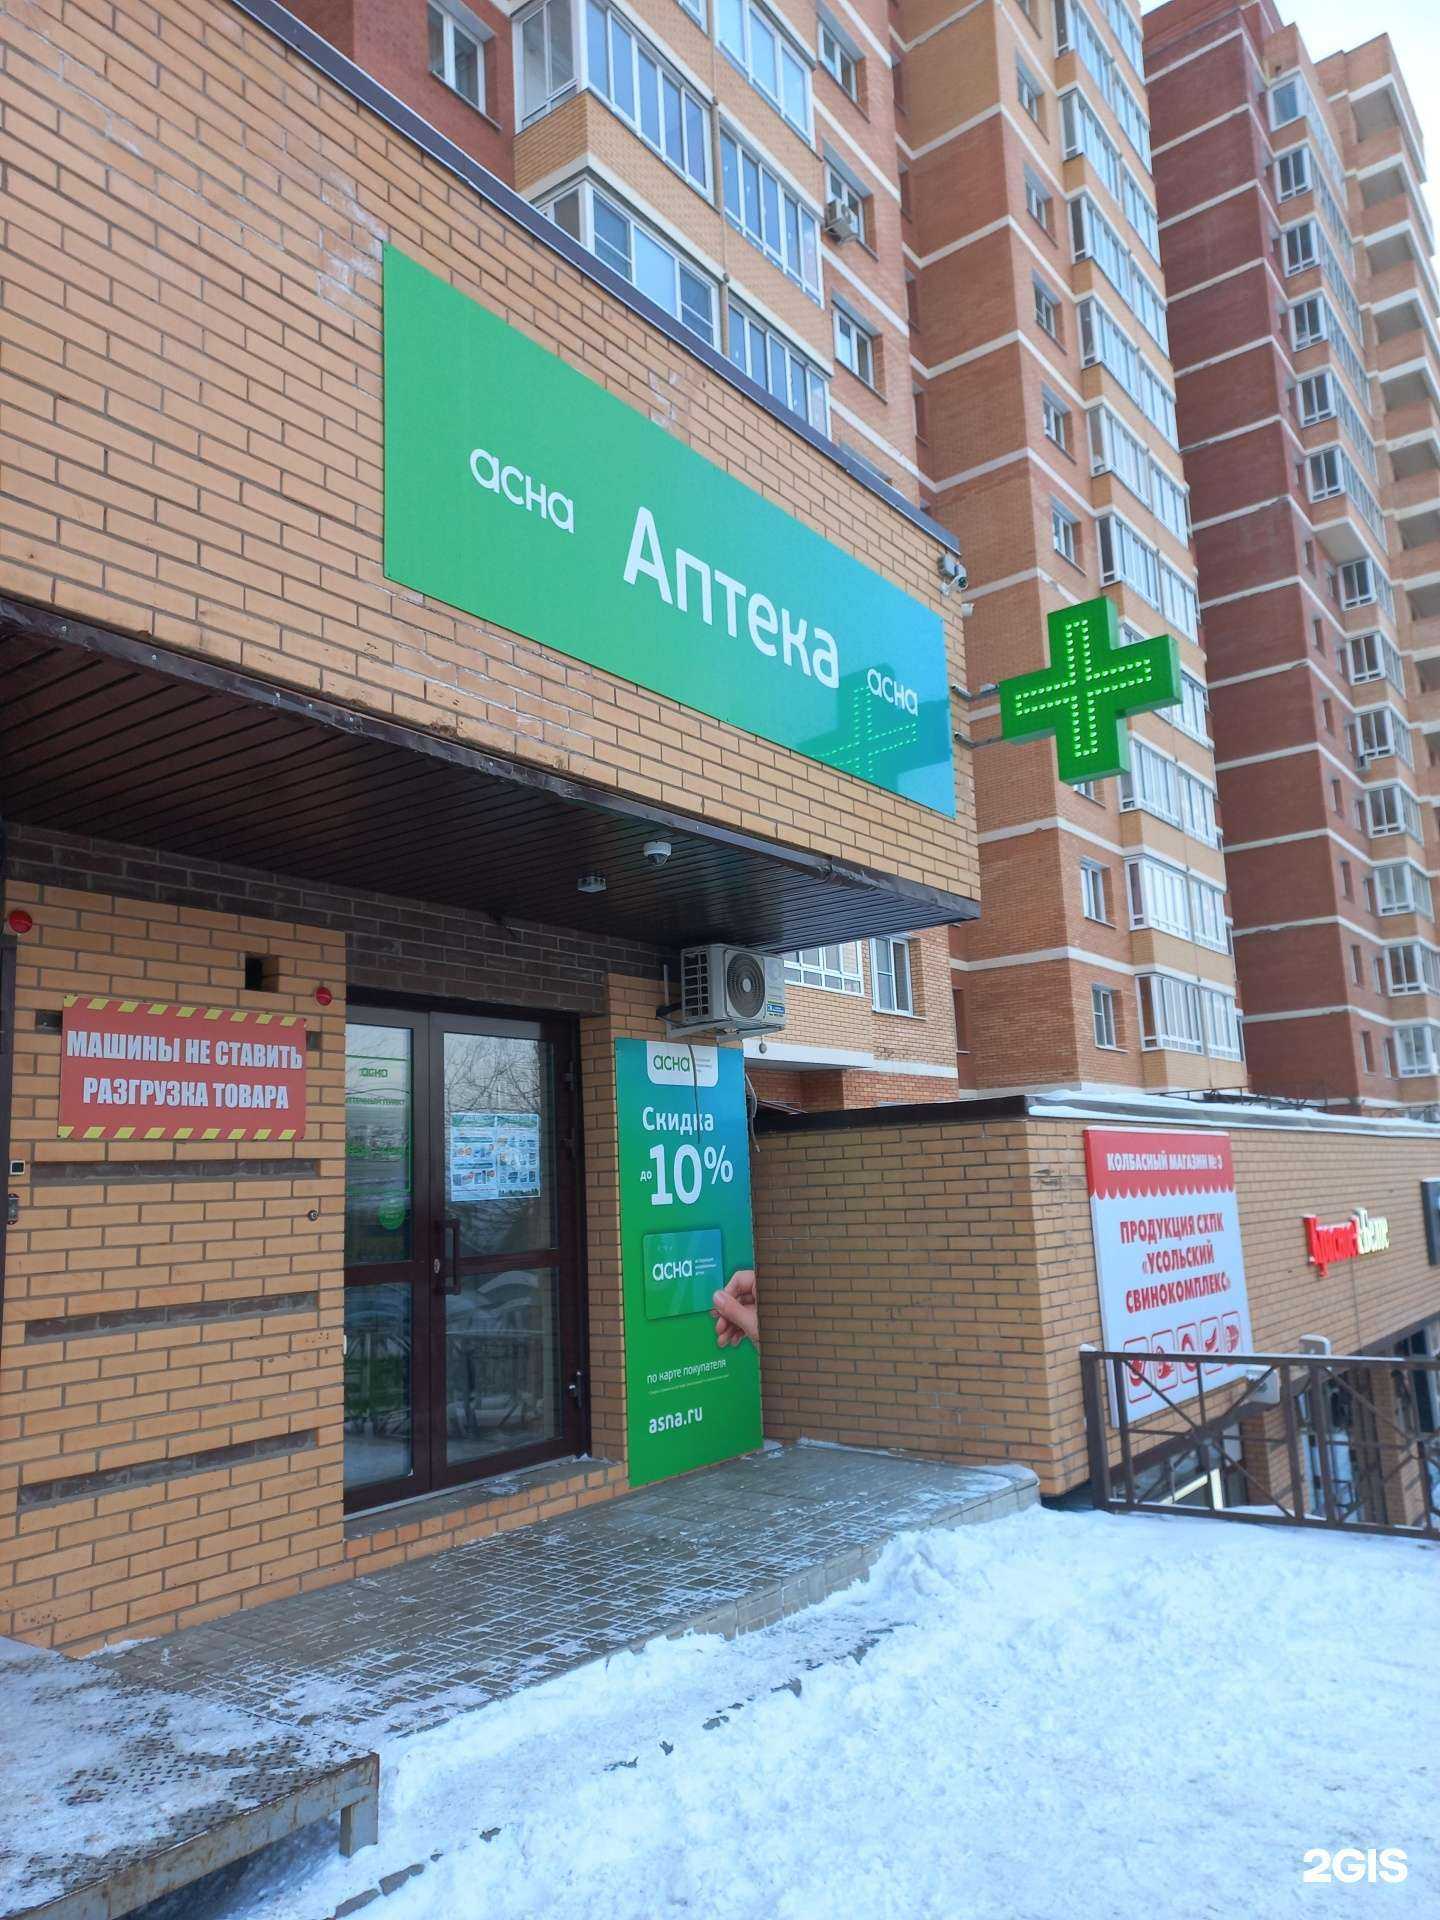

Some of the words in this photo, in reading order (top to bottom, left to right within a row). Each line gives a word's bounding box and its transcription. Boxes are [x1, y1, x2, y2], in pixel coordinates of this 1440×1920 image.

[469, 448, 575, 534] асна
[623, 506, 840, 689] Аптека
[866, 668, 919, 716] асна
[66, 1030, 180, 1063] МАШИНЫ
[185, 1038, 211, 1065] НЕ
[215, 1040, 303, 1070] СТАВИТЬ
[653, 1054, 691, 1072] асна
[83, 1077, 209, 1107] РАЗГРУЗКА
[213, 1083, 289, 1110] ТОВАРА
[642, 1106, 714, 1136] Скидка
[640, 1170, 653, 1182] до
[649, 1143, 734, 1206] 10%
[1106, 1150, 1169, 1172] КОЛБАСНЫЙ
[1169, 1153, 1208, 1171] МАГАЗИН
[1120, 1215, 1195, 1245] ПРОДУКЦИЯ
[1197, 1212, 1224, 1235] СХПК
[652, 1259, 693, 1281] асна
[1142, 1238, 1215, 1275] «УСОЛЬСКИЙ
[646, 1373, 658, 1384] по
[659, 1368, 682, 1382] карте
[683, 1359, 727, 1377] покупателя
[648, 1406, 703, 1434] asna.ru
